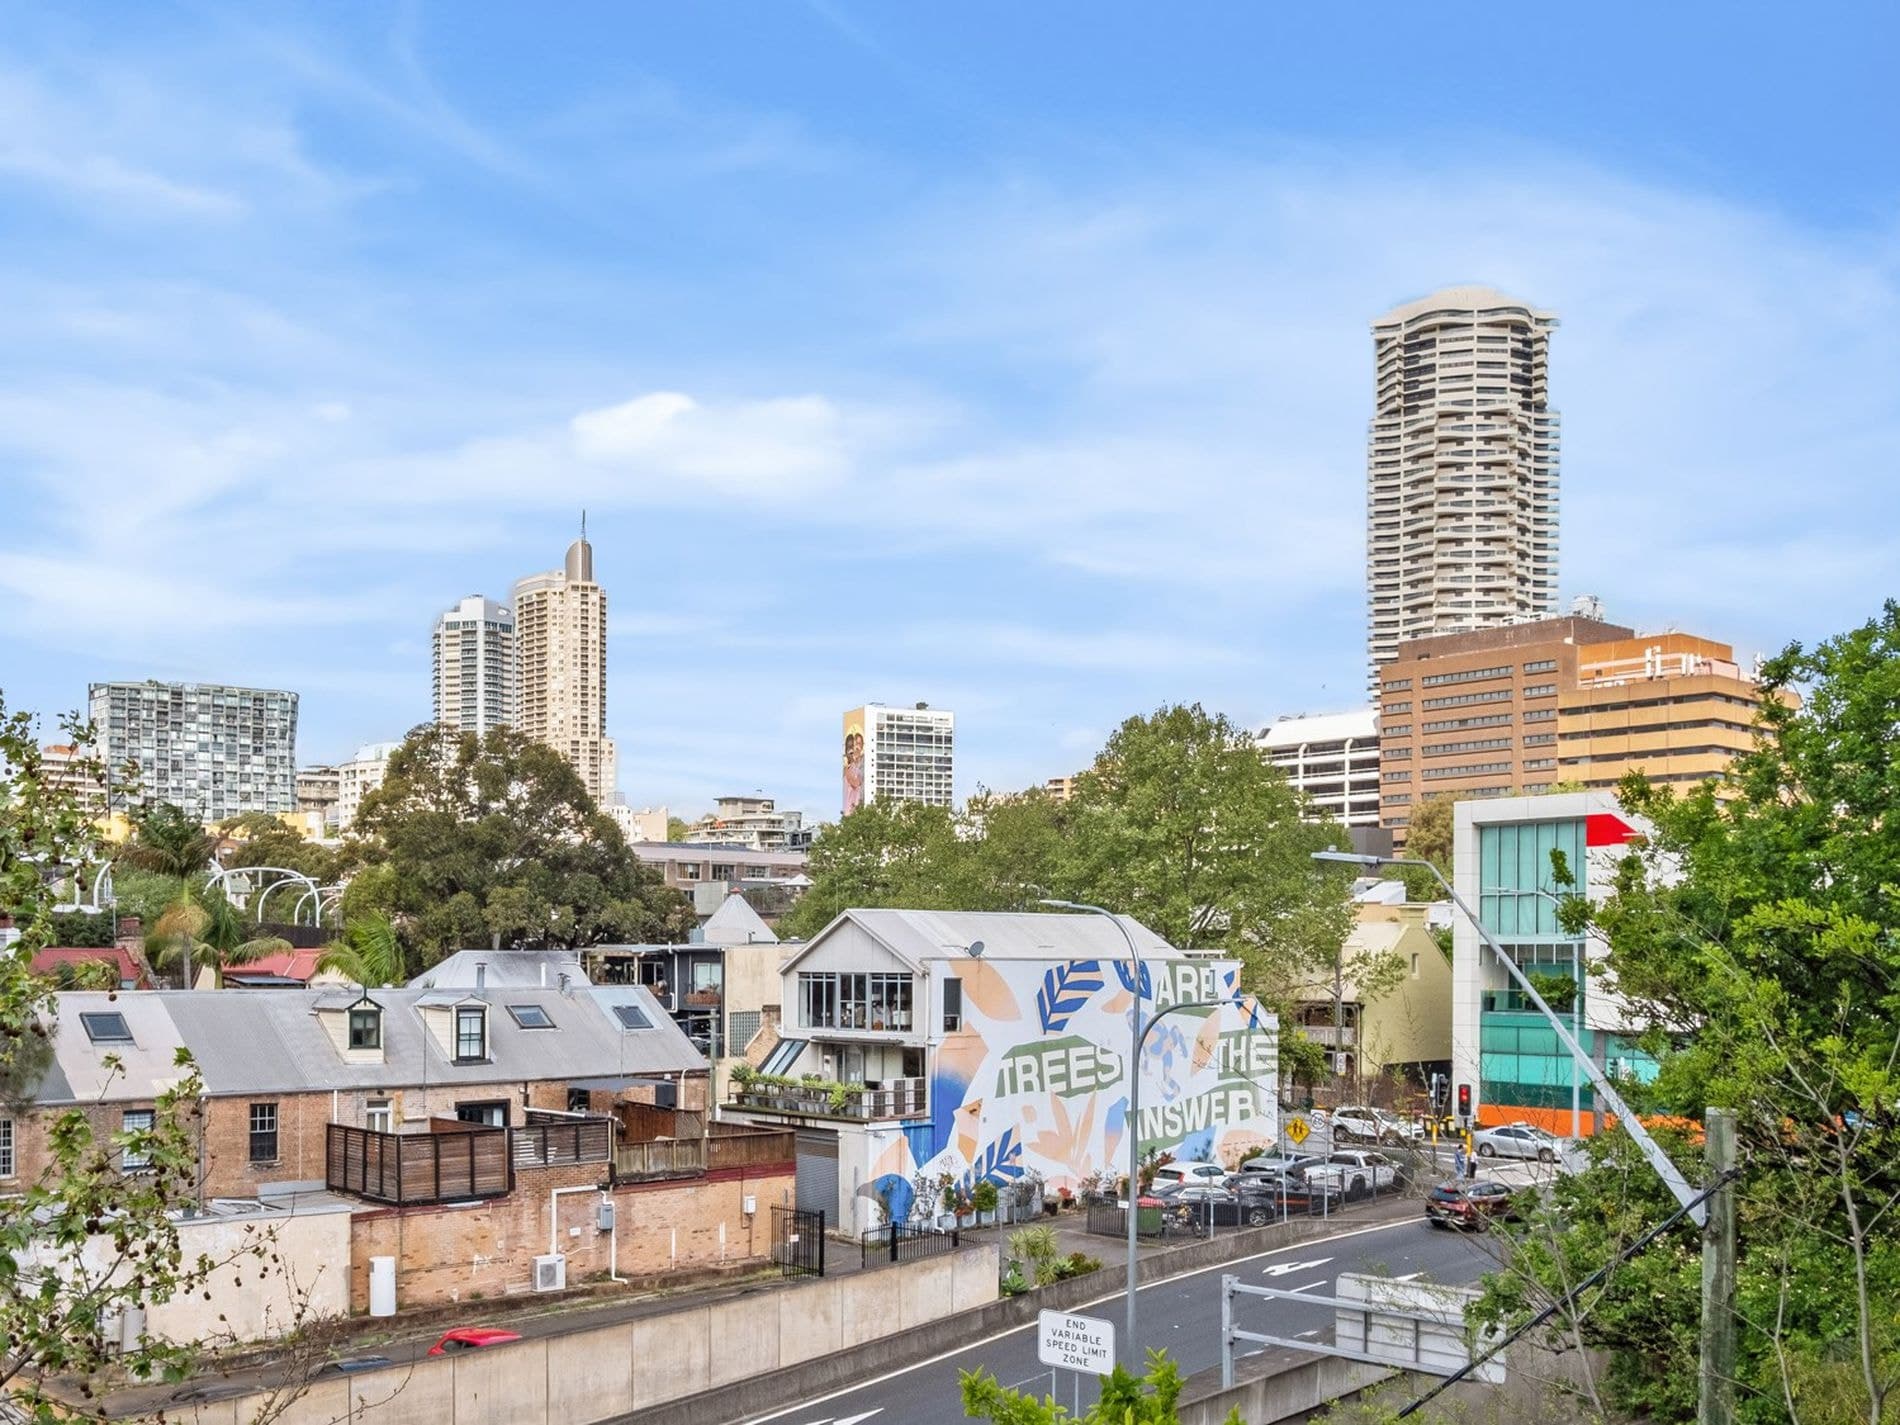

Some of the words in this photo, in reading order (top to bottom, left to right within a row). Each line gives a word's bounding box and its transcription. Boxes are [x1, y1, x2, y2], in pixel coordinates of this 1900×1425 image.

[1157, 964, 1219, 1005] ARE
[1216, 1035, 1278, 1074] THE
[999, 1046, 1121, 1096] TREES
[1066, 1319, 1086, 1330] END
[1051, 1328, 1102, 1345] VARIABLE
[1046, 1339, 1077, 1352] SPEED
[1082, 1346, 1107, 1358] LIMIT
[1063, 1354, 1089, 1367] ZONE
